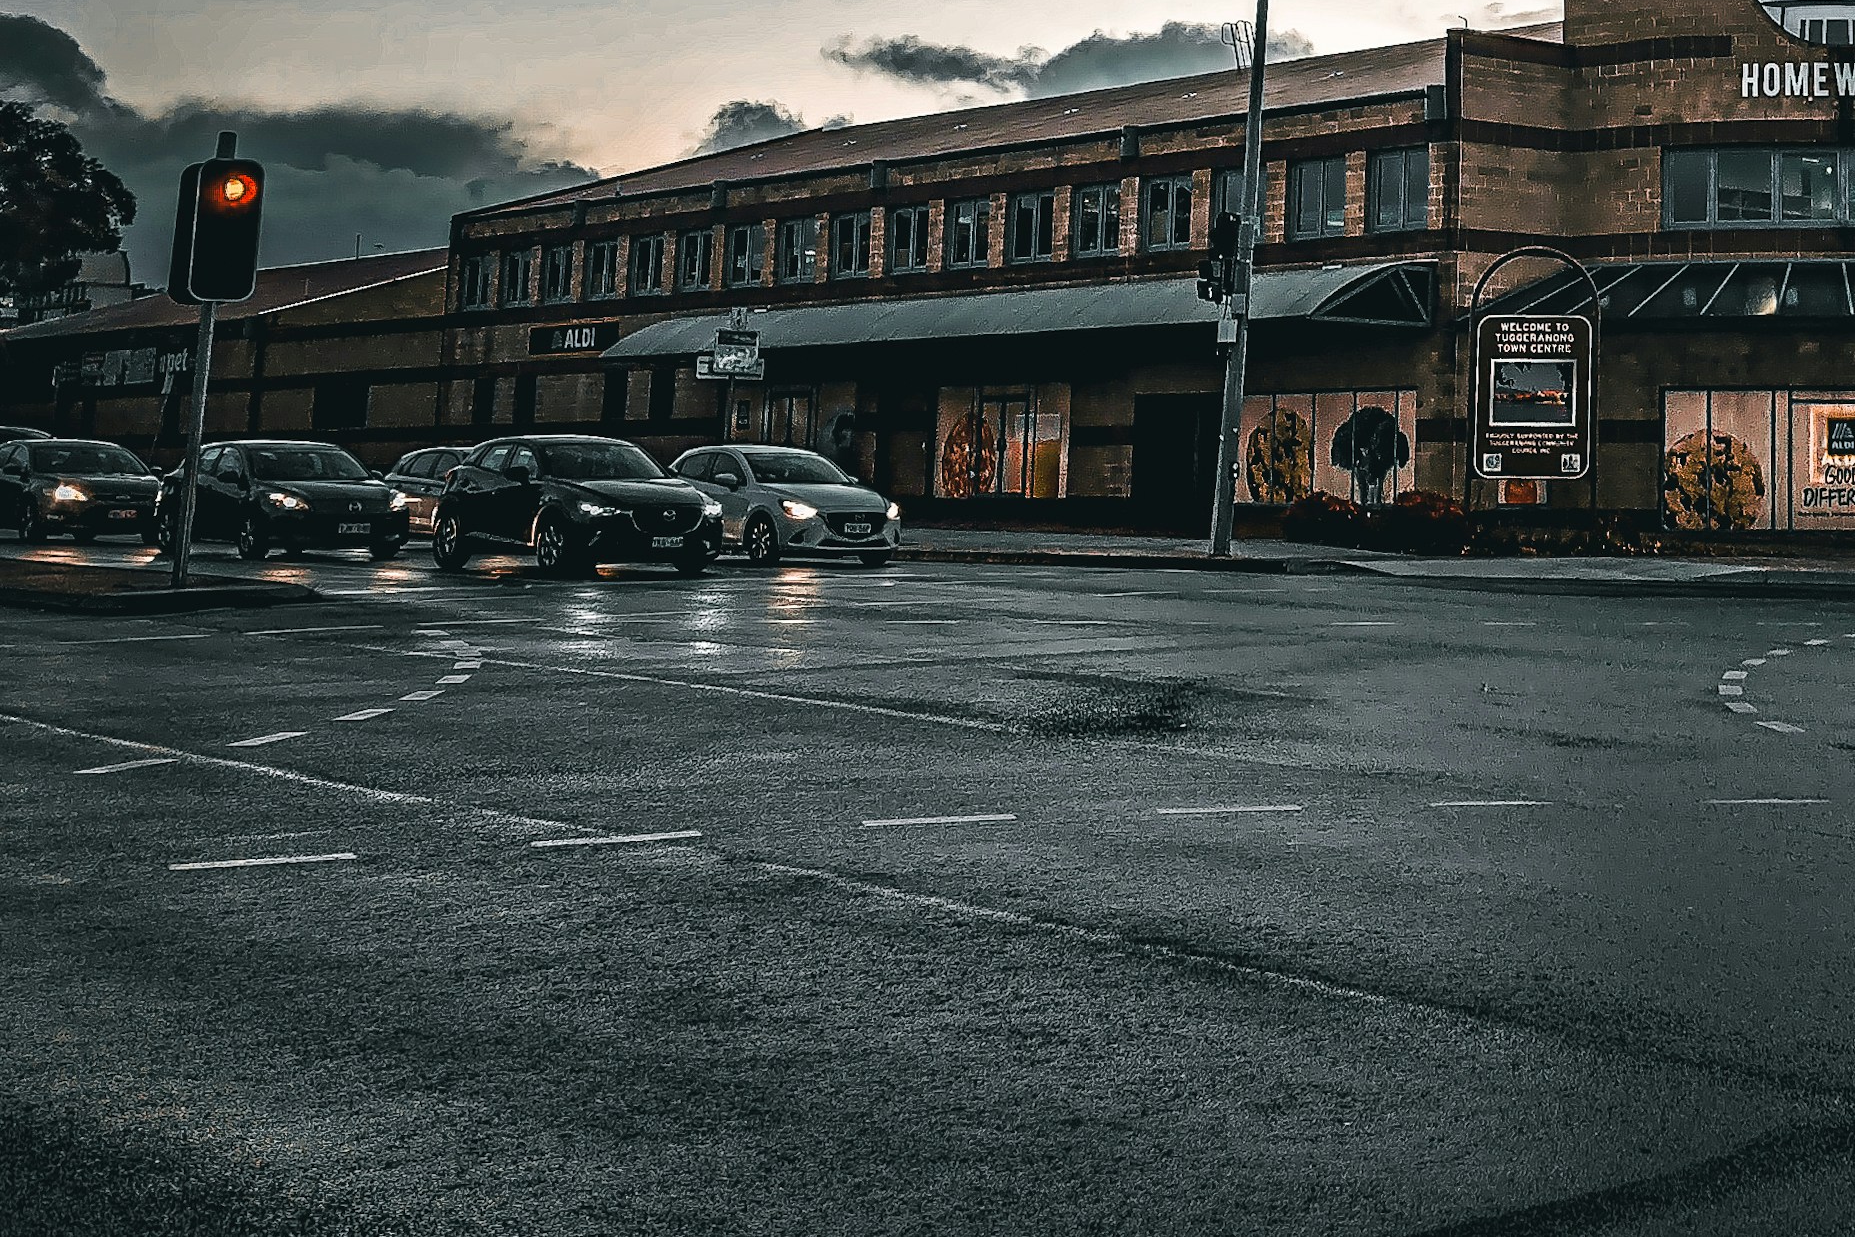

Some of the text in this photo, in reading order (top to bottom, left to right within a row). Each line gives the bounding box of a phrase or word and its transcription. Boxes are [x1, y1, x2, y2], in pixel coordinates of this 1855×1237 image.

[1501, 323, 1570, 332] WELCOME TO
[564, 327, 596, 349] ALDI
[1498, 344, 1572, 353] TOWN CENTRE
[1832, 441, 1855, 449] ALDI
